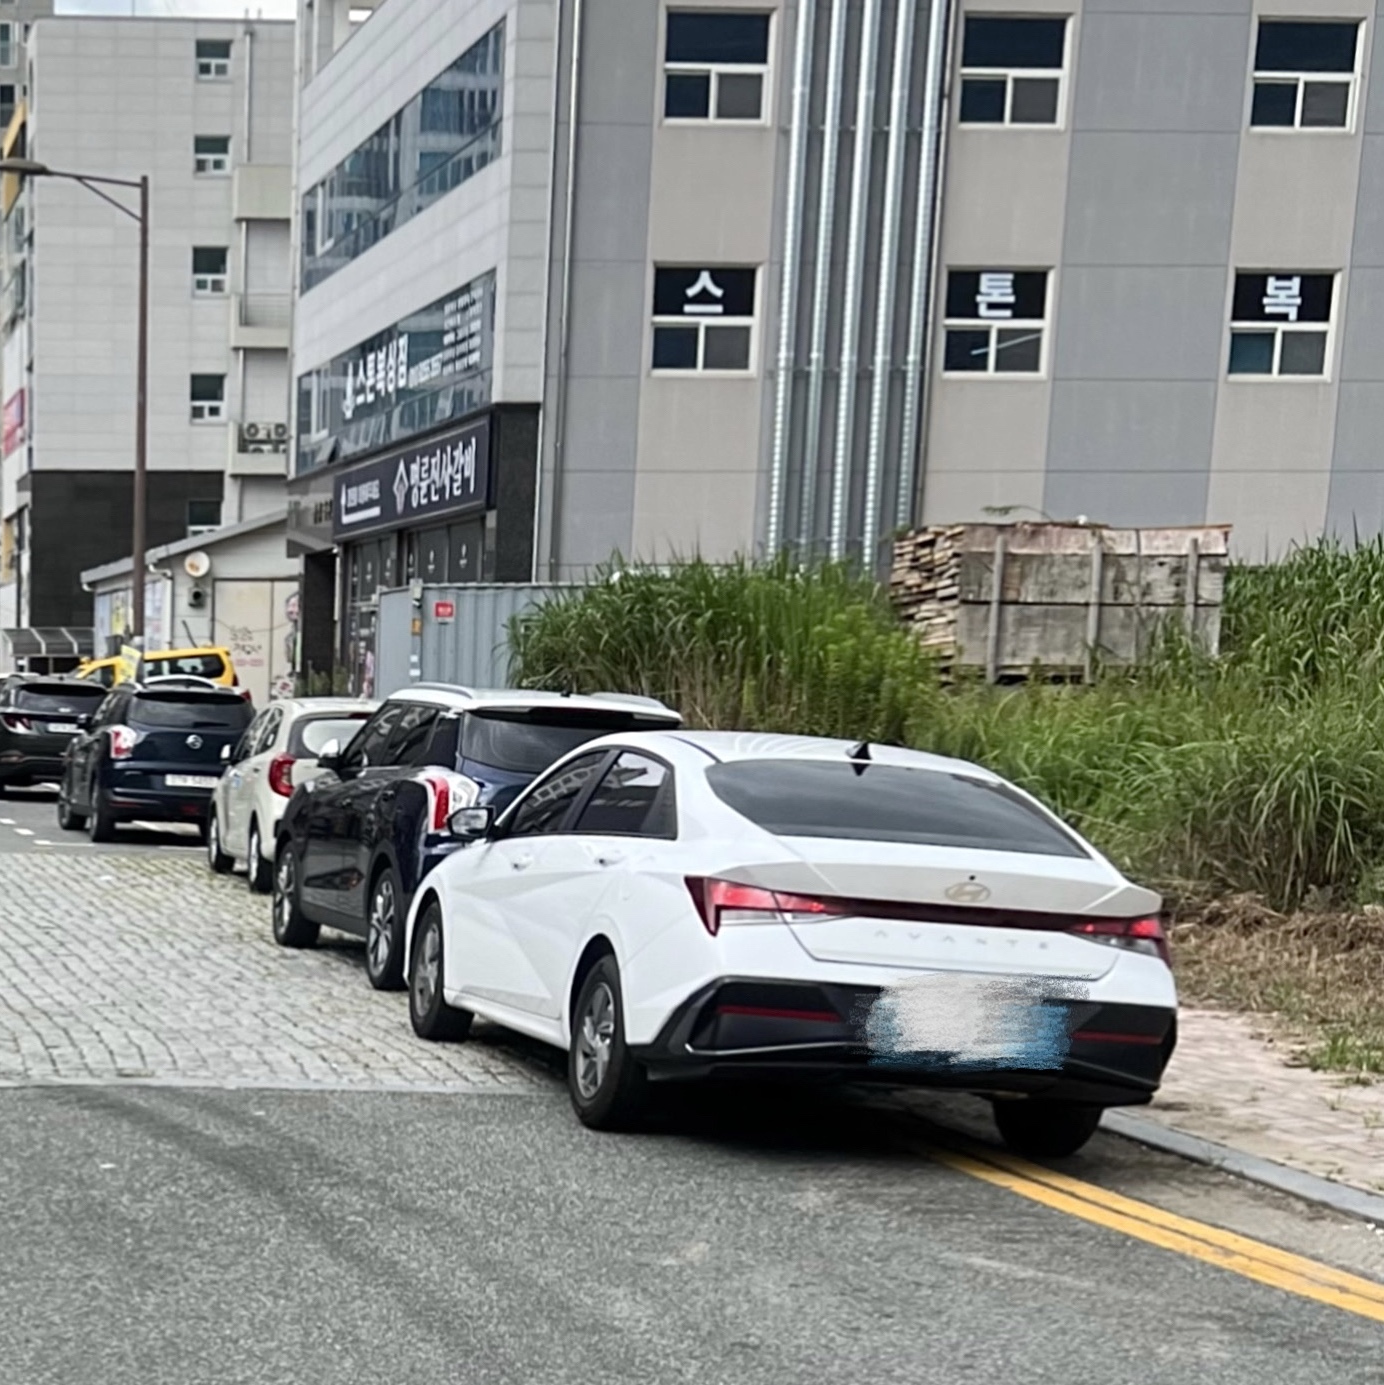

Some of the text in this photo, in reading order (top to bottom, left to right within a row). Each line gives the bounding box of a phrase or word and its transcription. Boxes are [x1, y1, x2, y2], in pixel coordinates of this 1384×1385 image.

[683, 272, 1302, 321] 스 톤 복
[410, 437, 476, 508] 명륜진사갈비
